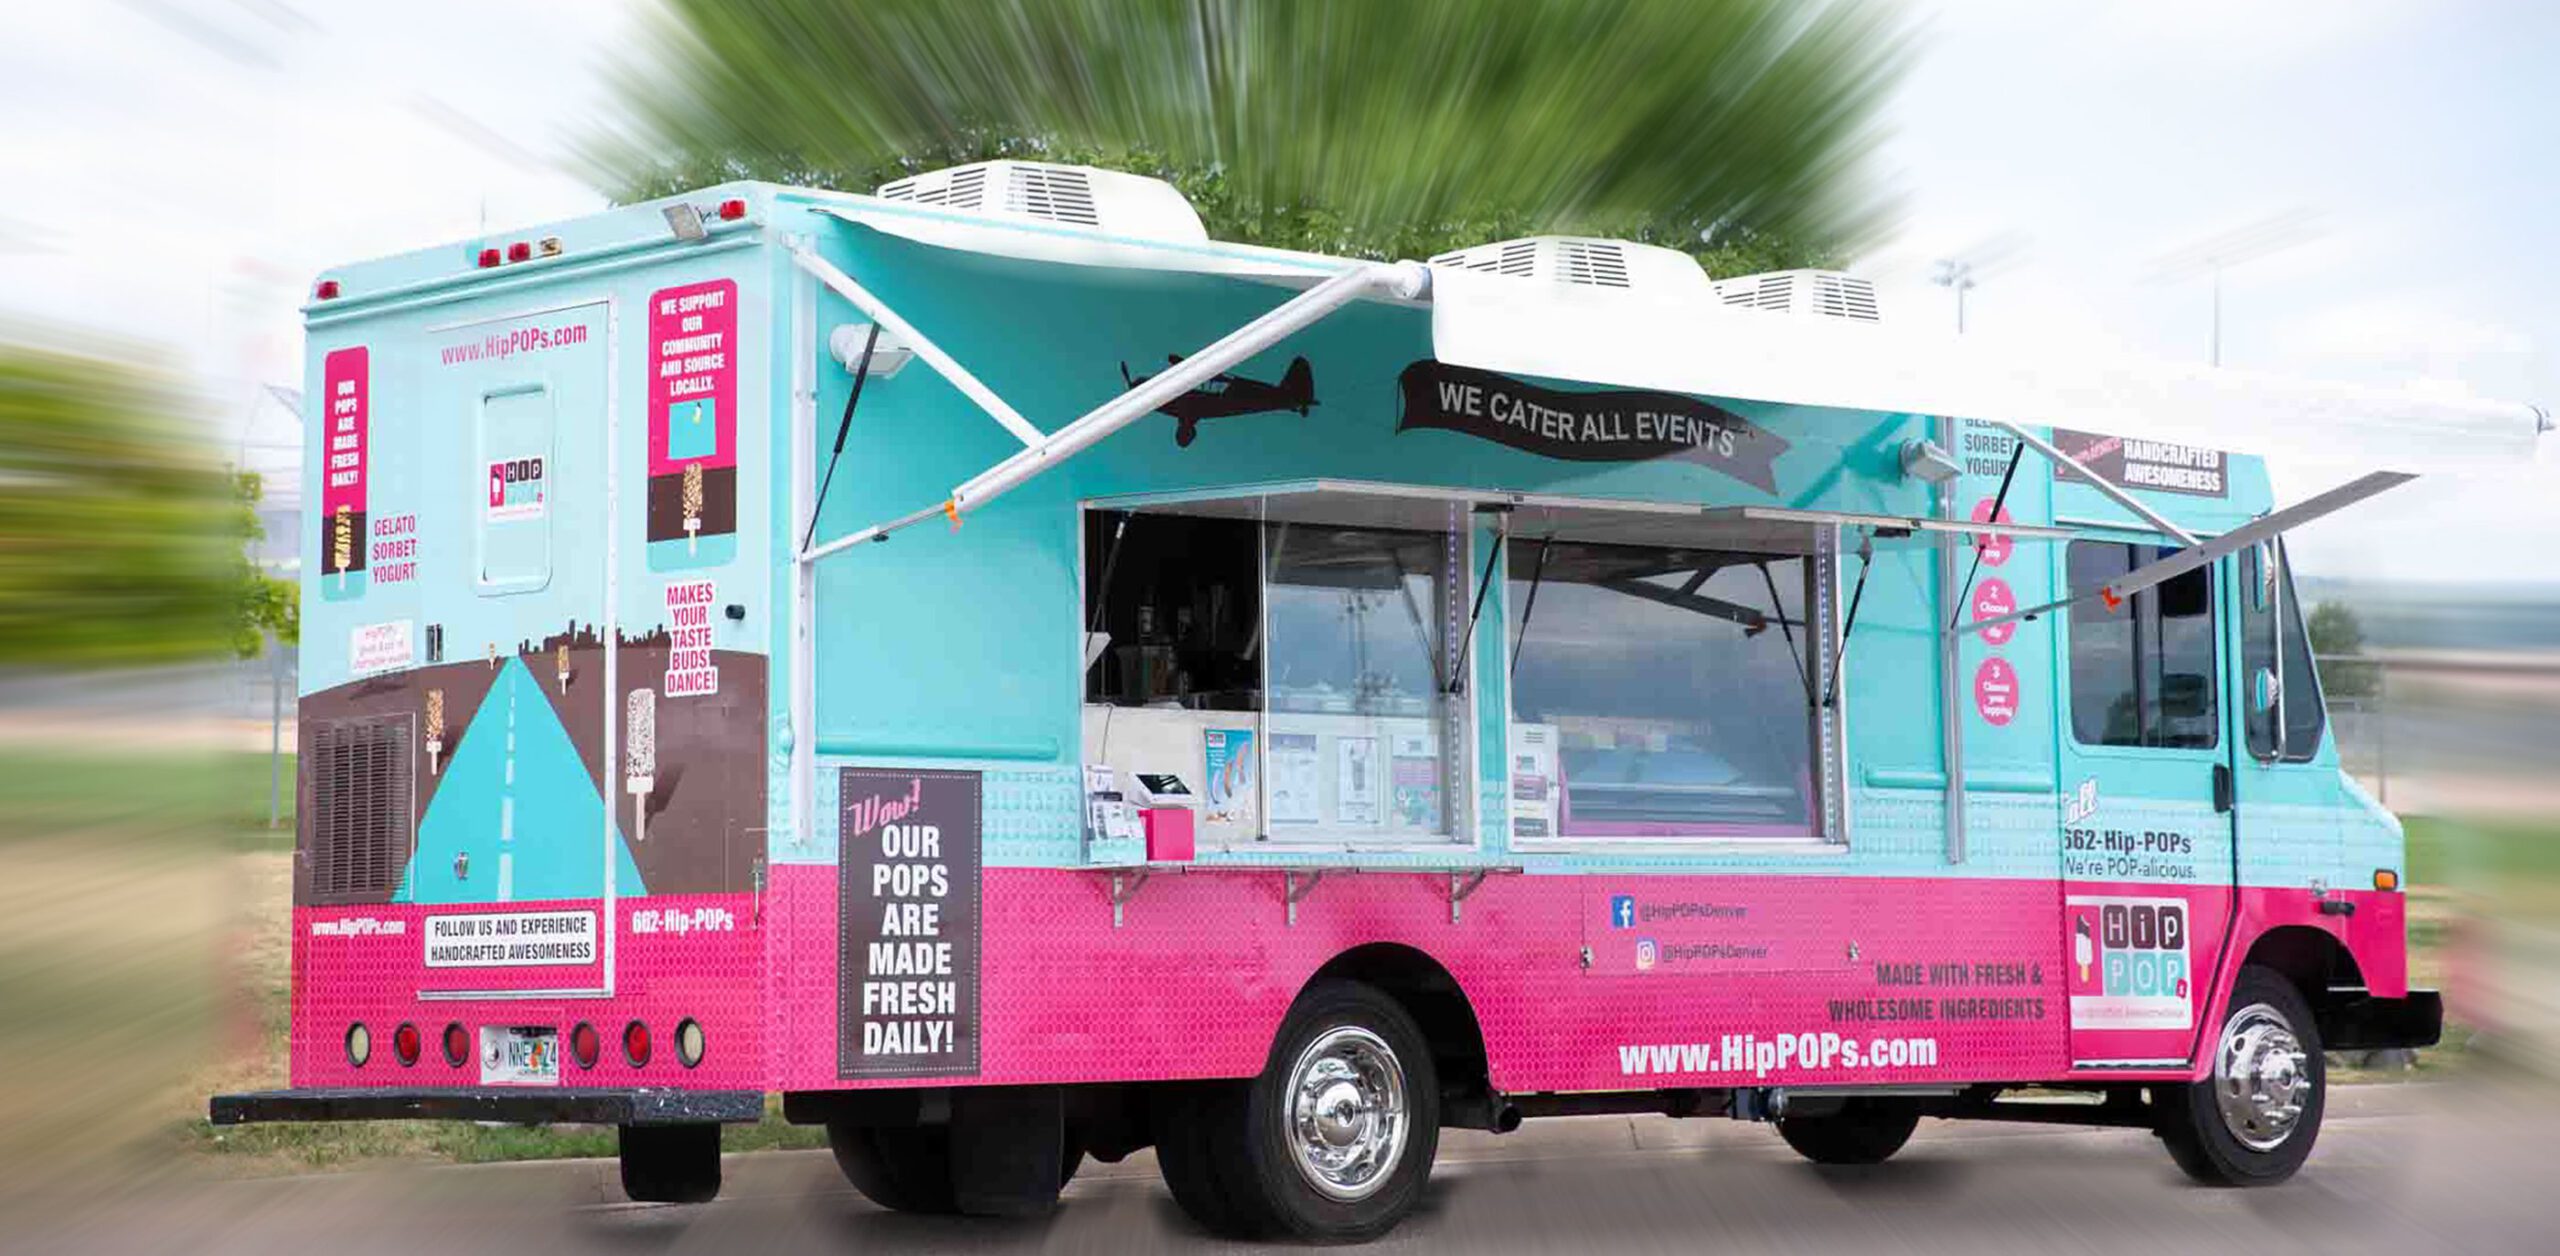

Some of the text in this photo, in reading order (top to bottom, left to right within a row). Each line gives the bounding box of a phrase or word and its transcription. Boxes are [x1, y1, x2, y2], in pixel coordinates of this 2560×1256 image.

[661, 290, 725, 315] WE SUPPORT
[682, 316, 703, 332] OUR
[441, 323, 588, 365] www.HipPOPs.com
[662, 332, 724, 356] COMMUNITY
[661, 353, 725, 378] AND SOURCE
[1439, 381, 1737, 458] WE CATER ALL EVENTS
[1964, 433, 2015, 456] SORBET
[2123, 438, 2219, 469] HANDCRAFTED
[2123, 462, 2220, 492] AWESOMENESS
[374, 514, 416, 537] GELATO
[372, 538, 417, 561] SORBET
[372, 562, 417, 585] YOGURT
[667, 582, 713, 607] MAKES
[672, 604, 707, 627] YOUR
[672, 626, 711, 649] TASTE
[672, 648, 707, 671] BUDS
[667, 669, 715, 694] DANCE!
[846, 778, 921, 838] Wow!
[2064, 778, 2097, 825] all
[880, 824, 941, 859] OUR
[871, 863, 949, 898] POPS
[2107, 857, 2197, 879] POP-alicious.
[881, 902, 940, 937] ARE
[1641, 903, 1747, 921] @HipPOPsDenver
[434, 916, 587, 938] FOLLOW US AND EXPERIENCE
[431, 942, 591, 962] HANDCRAFTED AWESOMENESS
[868, 942, 953, 976] MADE
[1664, 944, 1767, 963] @HipPOPsDenver
[1876, 963, 1924, 986] MADE
[1929, 964, 1970, 987] WITH
[1975, 963, 2027, 987] FRESH
[863, 981, 957, 1016] FRESH
[1828, 997, 2045, 1022] WHOLESOME INGREDIENTS
[863, 1020, 955, 1056] DAILY!
[1618, 1031, 1938, 1079] www.HipPOPs.com
